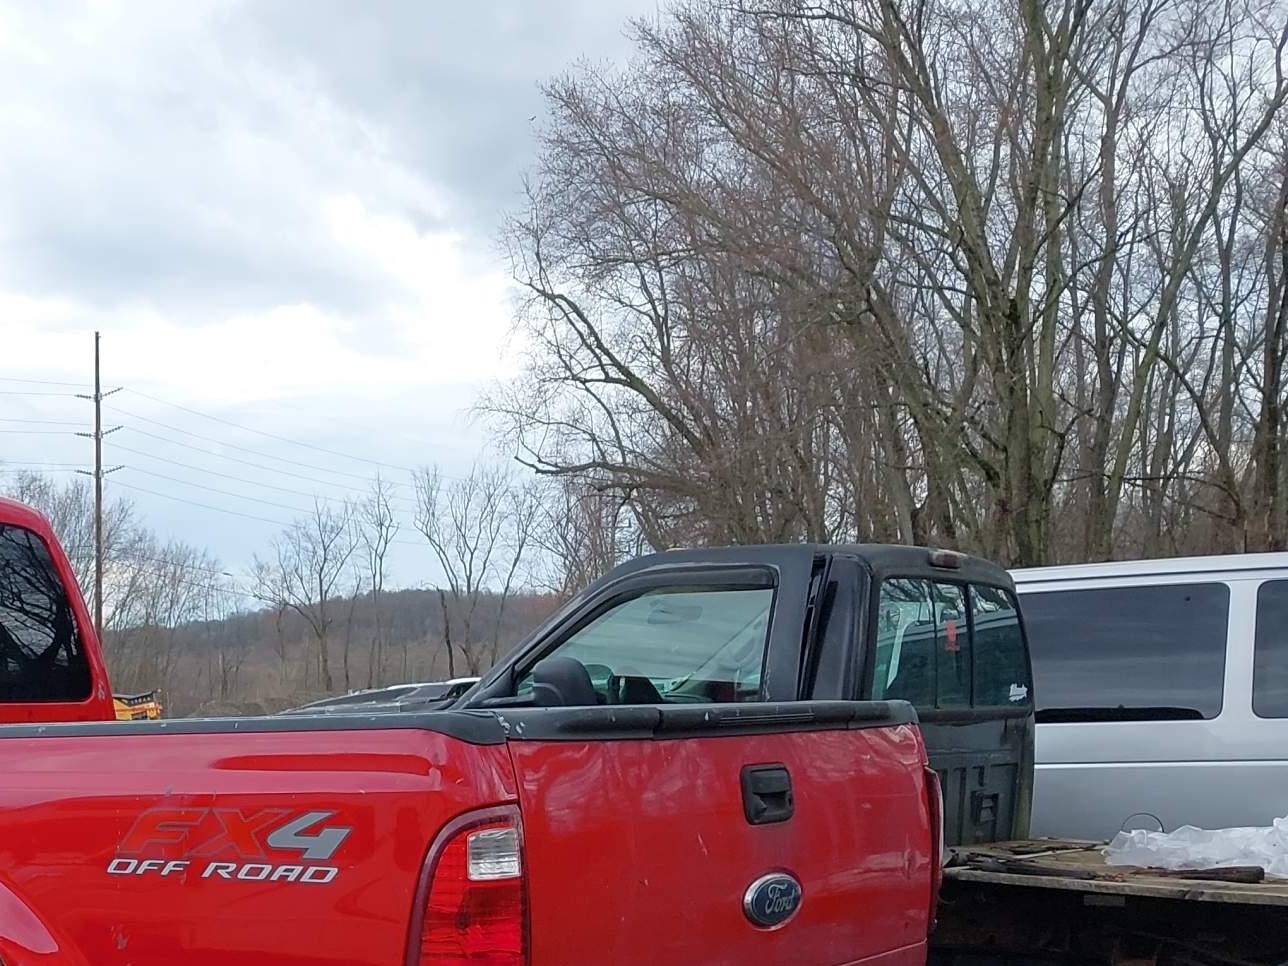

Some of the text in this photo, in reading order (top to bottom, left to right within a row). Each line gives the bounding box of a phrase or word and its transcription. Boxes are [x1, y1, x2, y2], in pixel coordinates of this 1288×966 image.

[117, 807, 353, 860] FX4
[106, 858, 338, 884] OFF ROAD
[765, 883, 795, 914] Ford
